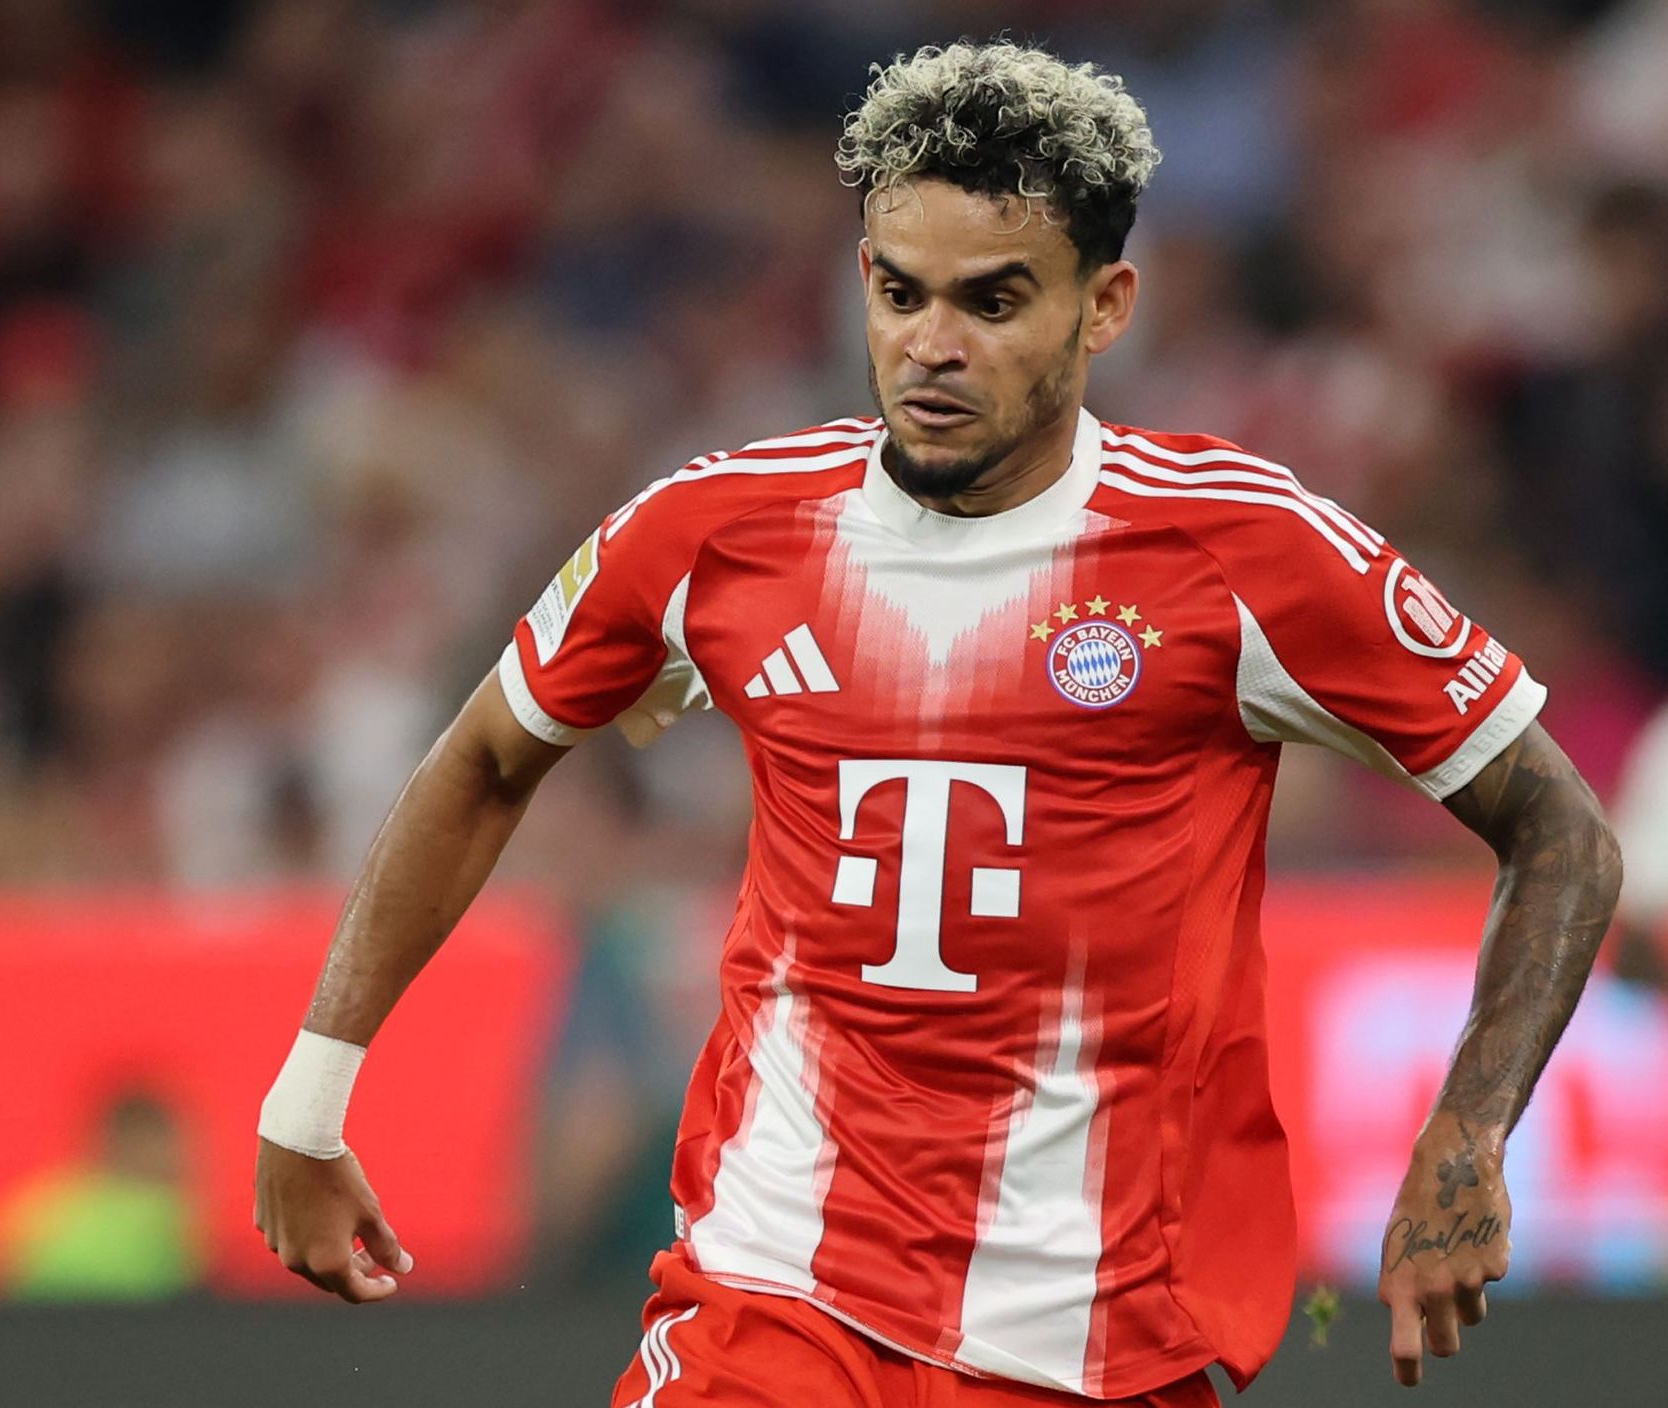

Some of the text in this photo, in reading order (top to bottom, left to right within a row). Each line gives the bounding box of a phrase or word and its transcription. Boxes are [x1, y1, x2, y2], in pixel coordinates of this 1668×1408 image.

[1057, 626, 1133, 661] FC BAYERN
[832, 759, 1027, 992] T
